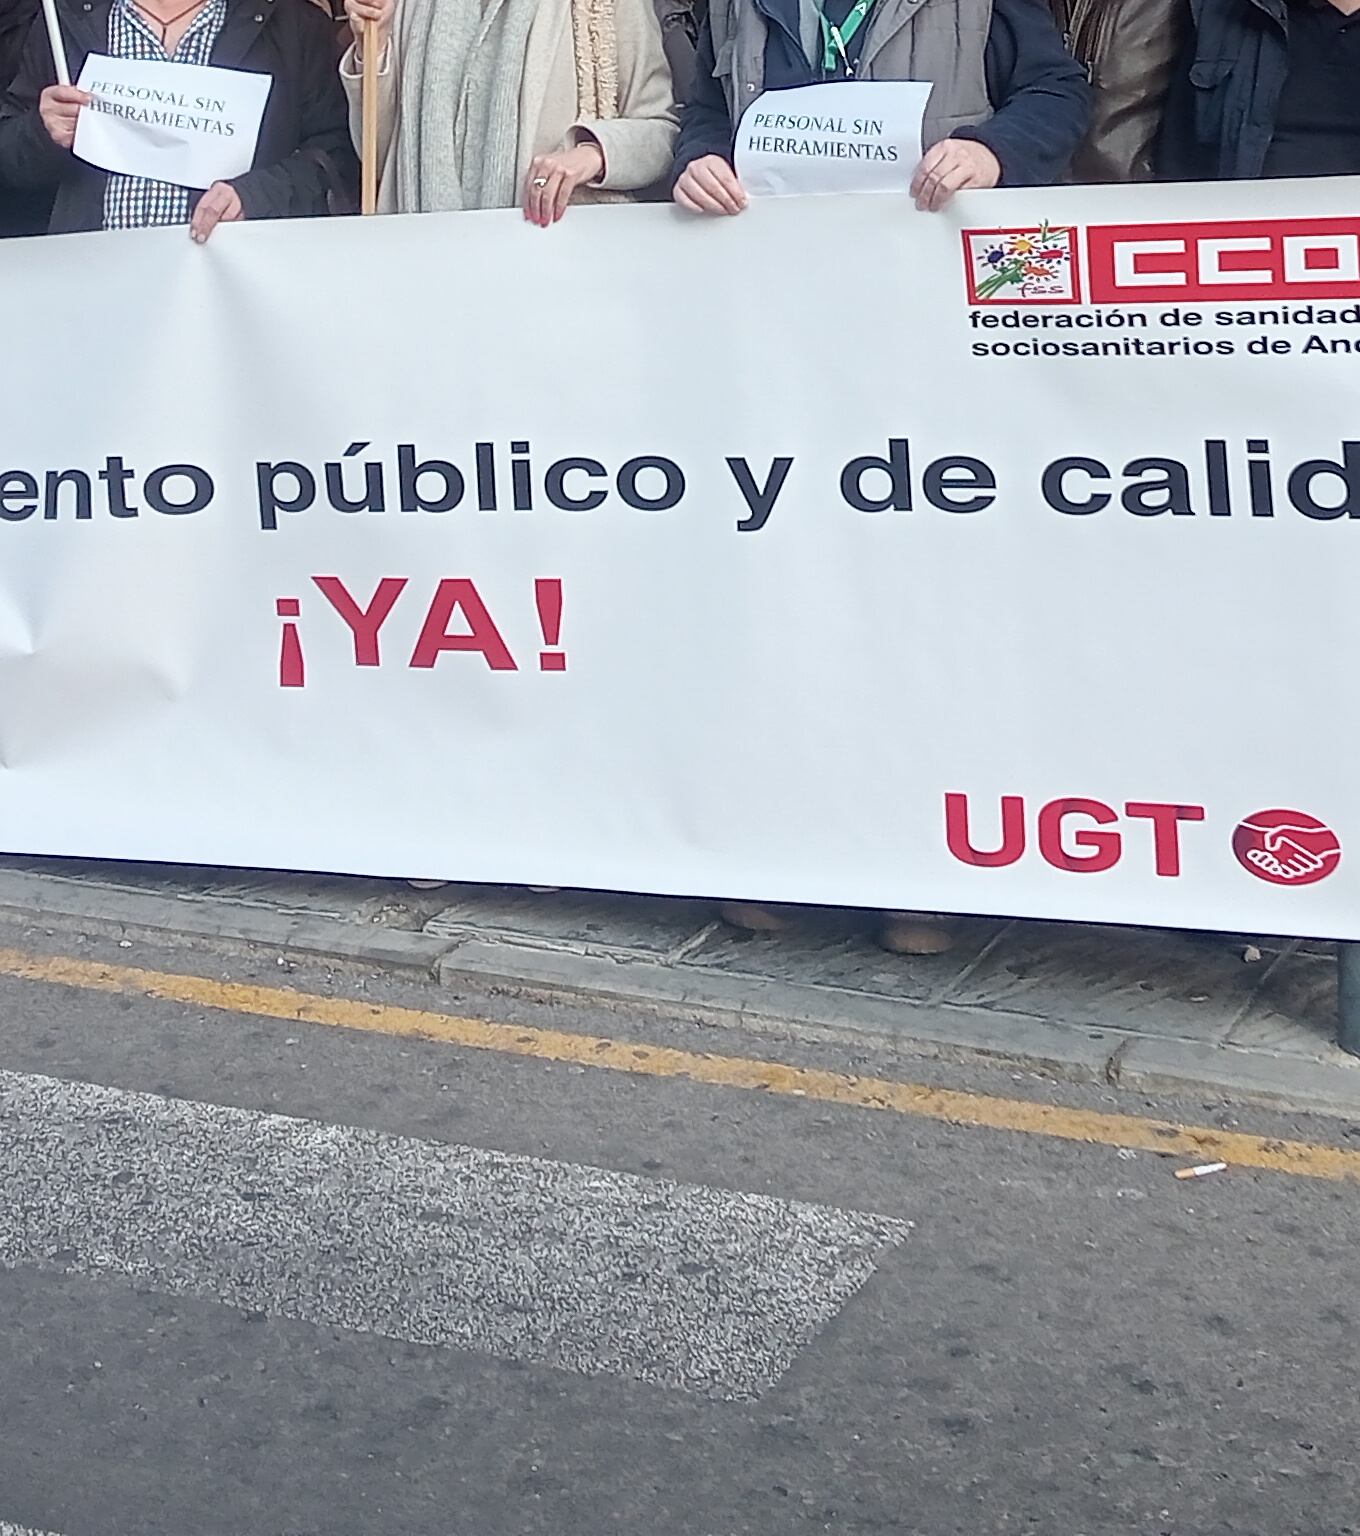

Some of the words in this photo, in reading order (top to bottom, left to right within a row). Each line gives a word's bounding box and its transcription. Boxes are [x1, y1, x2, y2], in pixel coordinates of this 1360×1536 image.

[90, 80, 191, 112] PERSONAL
[193, 96, 226, 114] SIN
[89, 97, 235, 137] HERRAMIENTAS
[753, 113, 848, 133] PERSONAL
[852, 119, 883, 137] SIN
[748, 136, 898, 162] HERRAMIENTAS
[969, 307, 1148, 330] federación
[1159, 305, 1204, 327] de
[971, 336, 1236, 357] sociosanitarios
[1246, 334, 1292, 356] de
[257, 439, 687, 530] público
[725, 456, 794, 531] y
[840, 439, 997, 518] de
[274, 575, 567, 688] ¡YA!
[943, 792, 1206, 878] UGT
